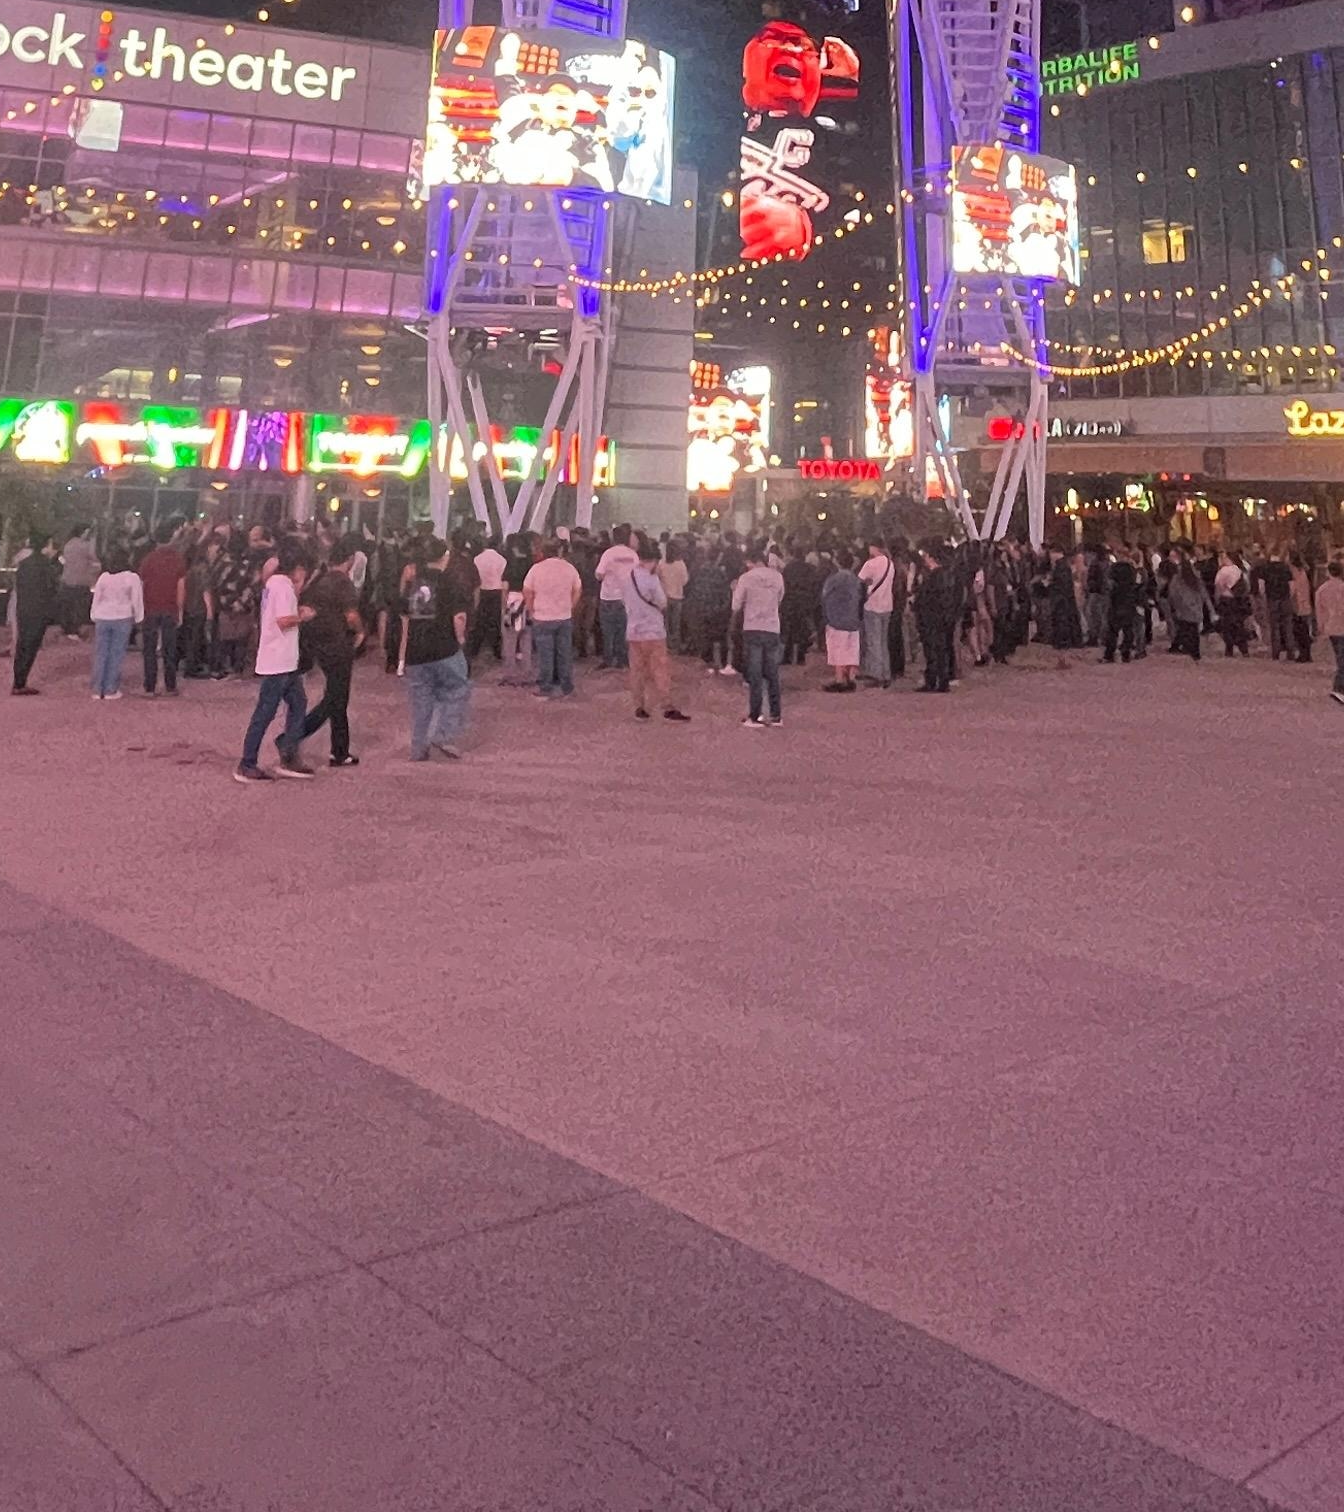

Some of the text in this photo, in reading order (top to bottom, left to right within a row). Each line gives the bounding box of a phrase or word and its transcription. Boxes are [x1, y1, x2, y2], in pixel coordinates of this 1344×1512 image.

[120, 27, 356, 102] theater
[1042, 41, 1137, 78] RBALIFE
[1043, 62, 1139, 97] TRITION
[797, 460, 880, 481] TOYOTA
